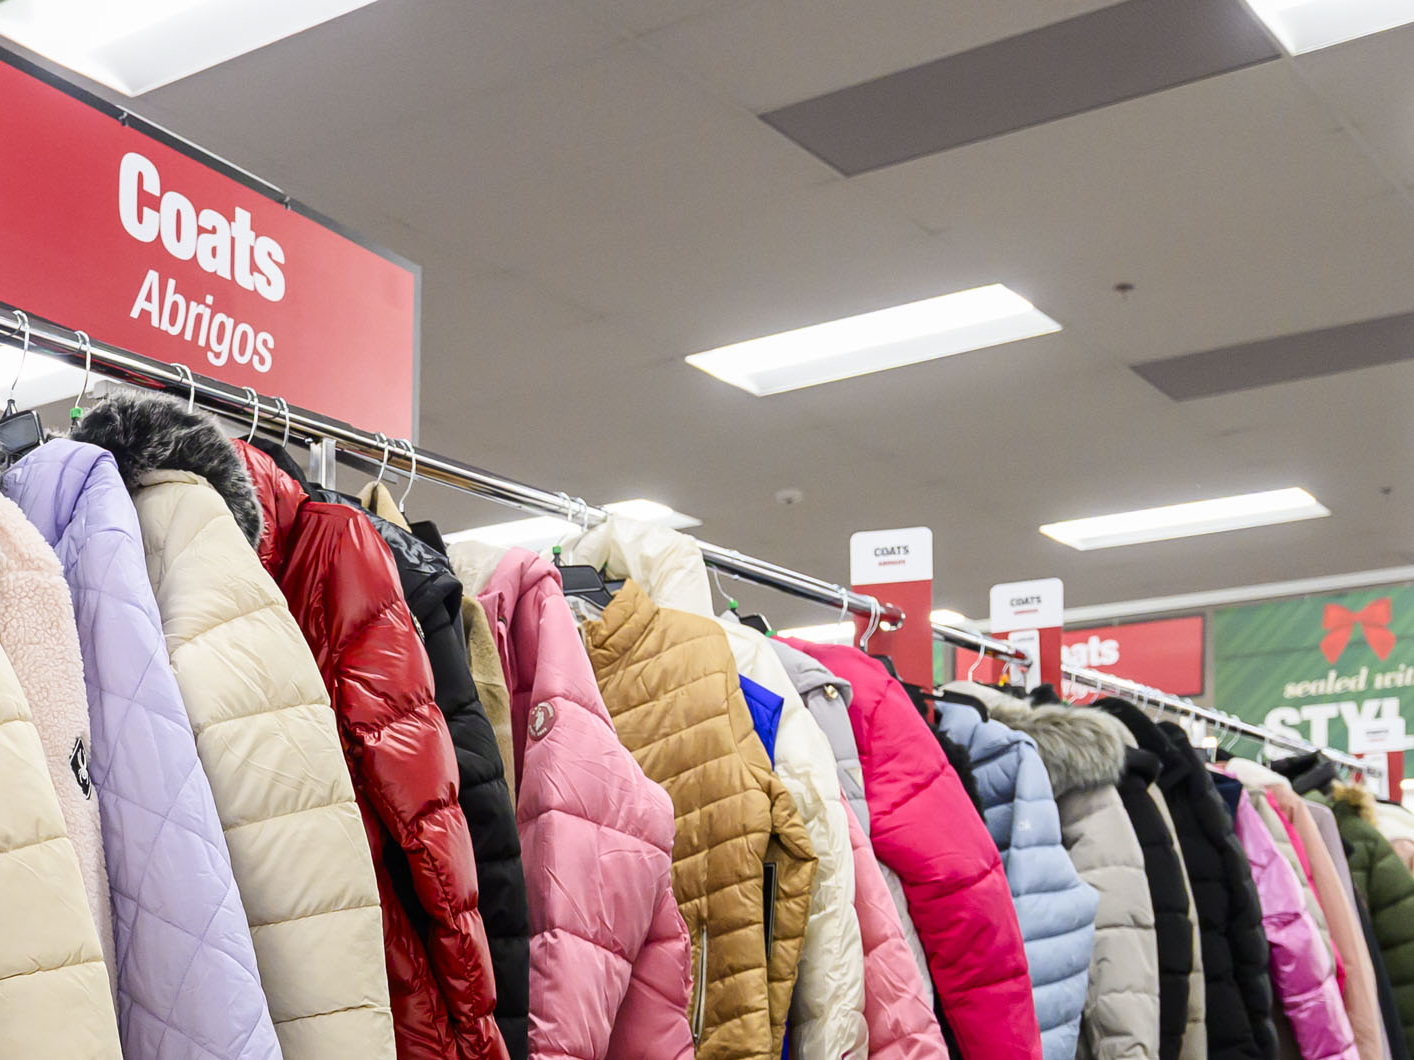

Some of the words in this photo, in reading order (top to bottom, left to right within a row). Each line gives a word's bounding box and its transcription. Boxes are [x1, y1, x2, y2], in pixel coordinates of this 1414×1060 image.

[118, 151, 286, 302] Coats
[129, 268, 276, 373] Abrigos
[873, 544, 911, 558] COATS
[1282, 669, 1369, 699] sealed
